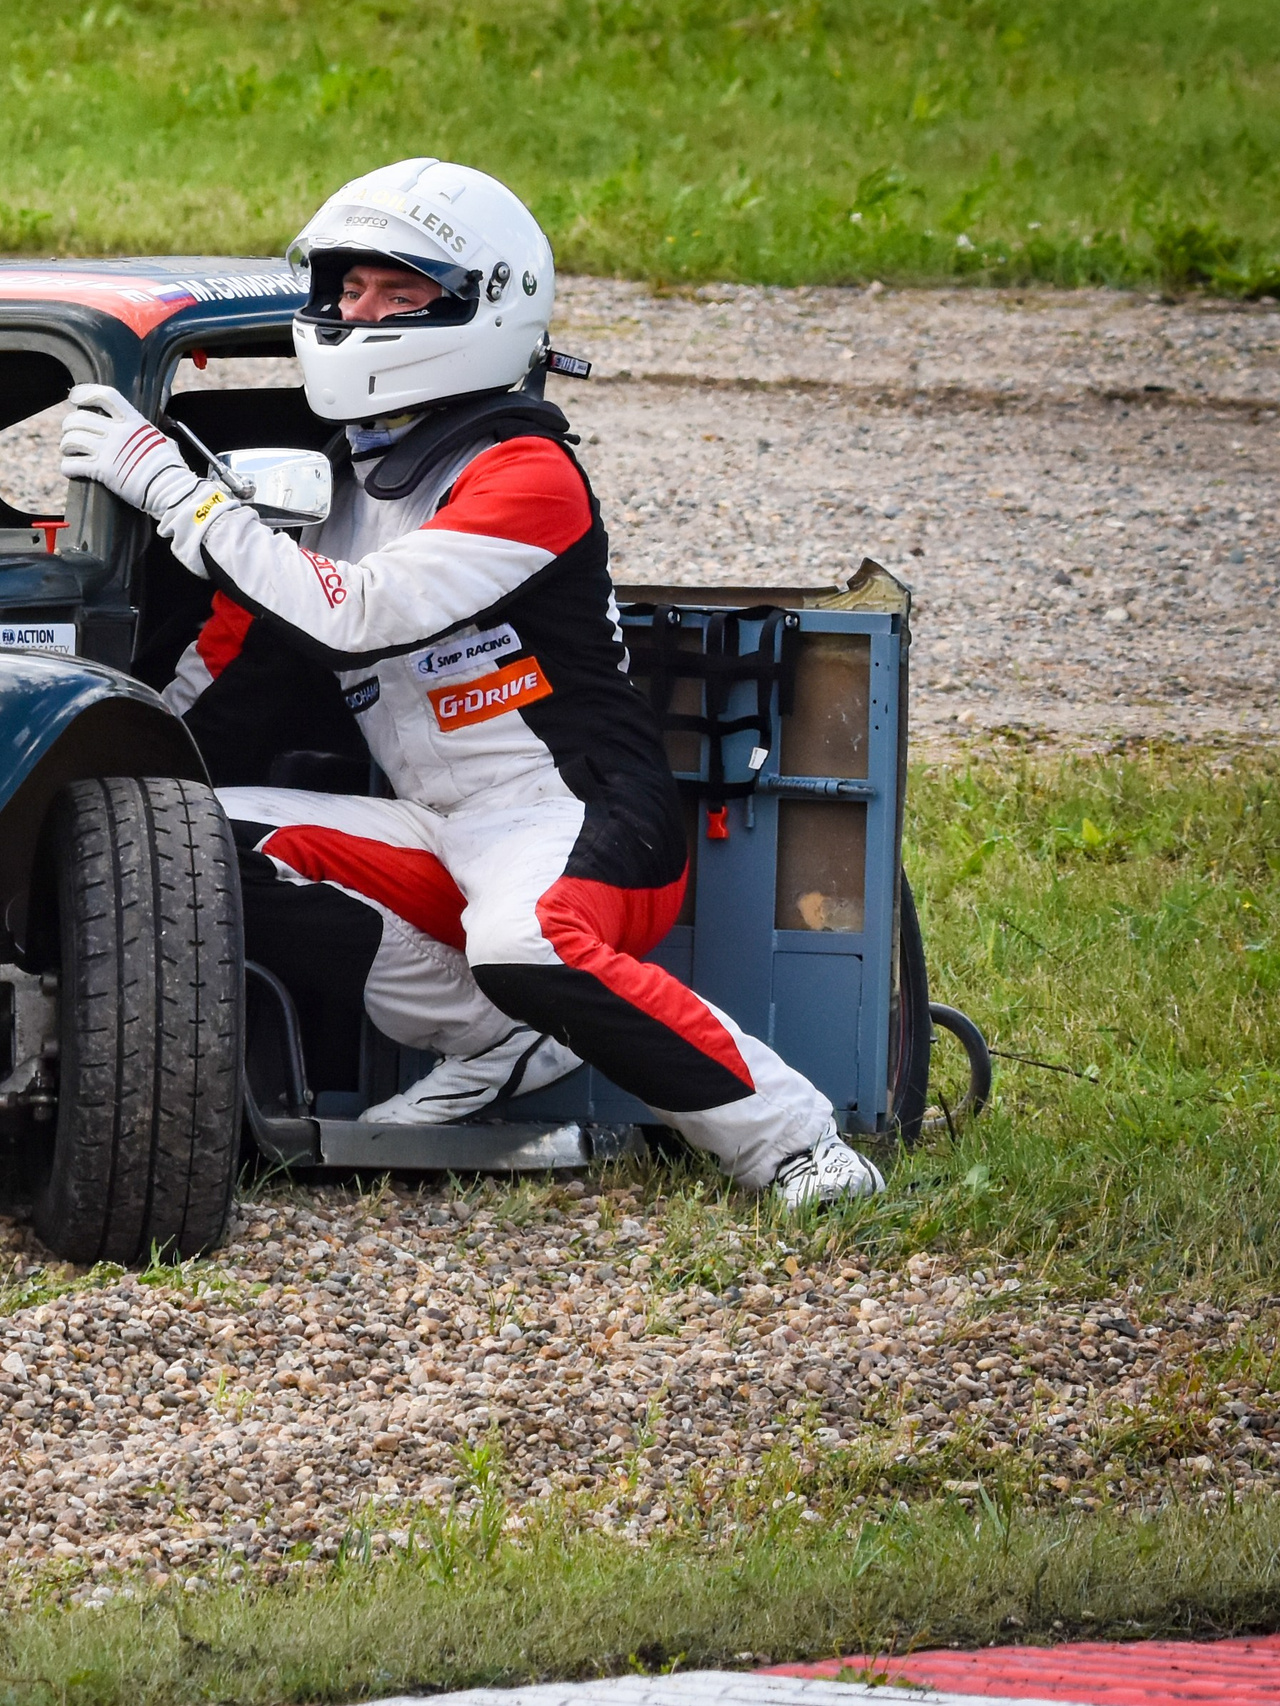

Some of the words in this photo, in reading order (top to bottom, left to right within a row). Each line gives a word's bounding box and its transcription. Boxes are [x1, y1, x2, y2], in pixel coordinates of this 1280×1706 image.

[17, 629, 54, 643] ACTION
[437, 651, 462, 668] SMP
[466, 634, 511, 659] RACING
